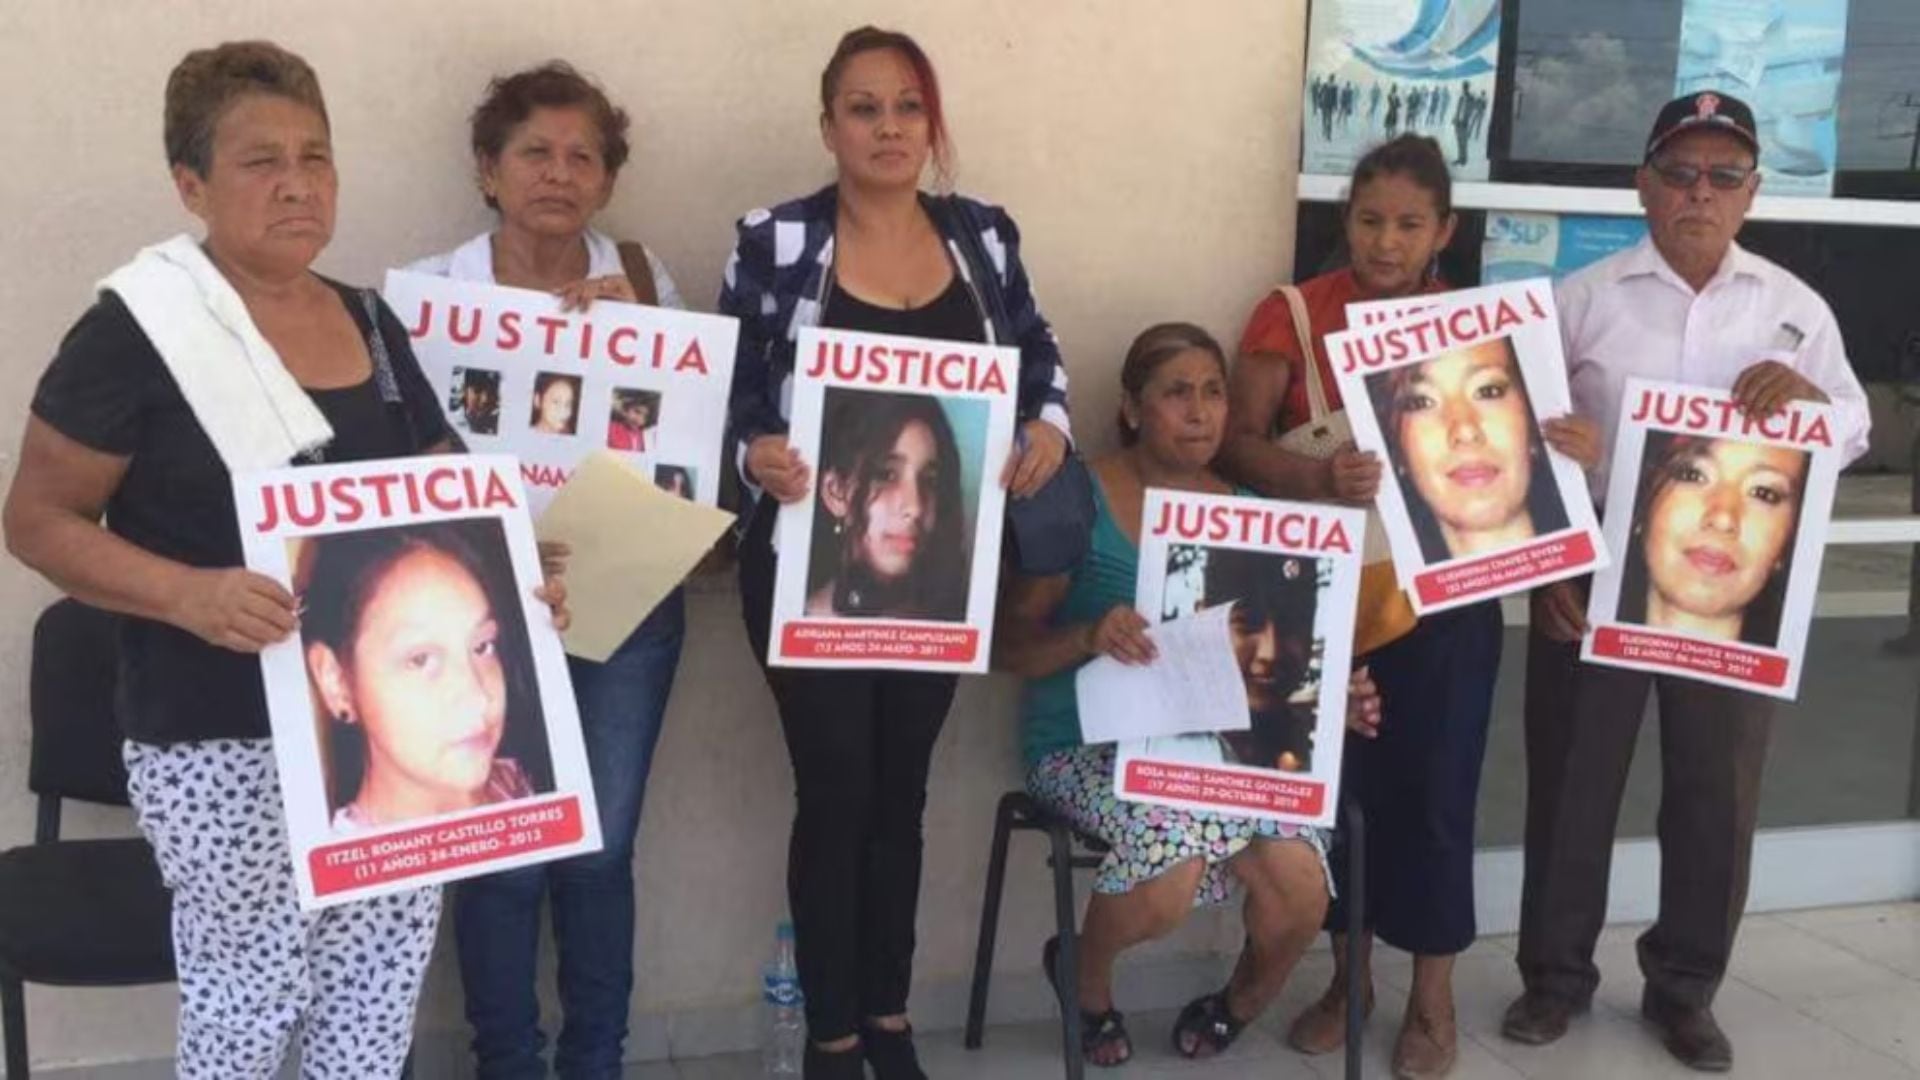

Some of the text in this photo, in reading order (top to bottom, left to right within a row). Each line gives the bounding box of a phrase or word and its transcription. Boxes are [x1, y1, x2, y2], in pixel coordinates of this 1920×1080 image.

[409, 300, 708, 375] JUSTICIA
[1342, 297, 1523, 373] JUSTICIA
[807, 341, 1007, 394] JUSTICIA
[256, 467, 518, 533] JUSTICIA
[1152, 501, 1353, 554] JUSTICIA
[794, 627, 842, 639] ADRIANA
[899, 631, 967, 643] CAMPUZANO
[1136, 765, 1164, 777] ROSA
[325, 806, 563, 866] ITZEL ROMANY CASTILLO TORRES
[353, 862, 377, 879] (11
[380, 850, 426, 872] AÑOS)
[508, 827, 542, 846] 2013
